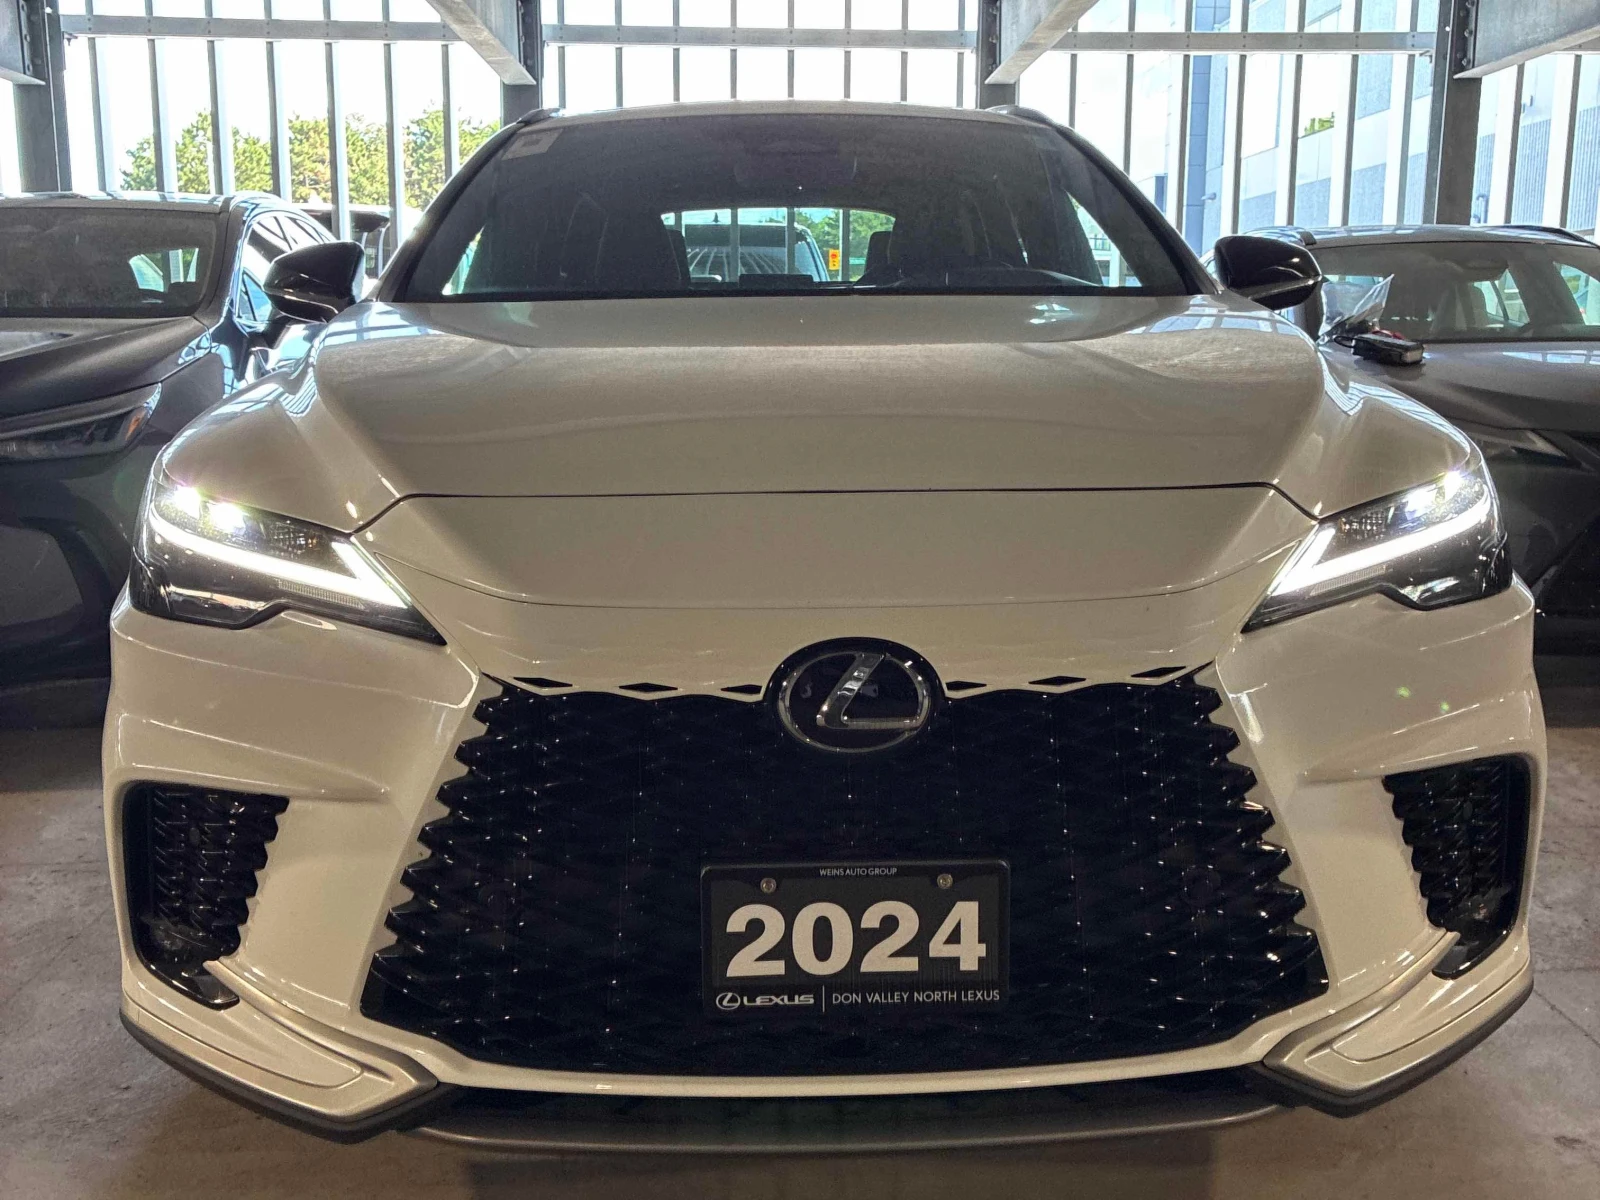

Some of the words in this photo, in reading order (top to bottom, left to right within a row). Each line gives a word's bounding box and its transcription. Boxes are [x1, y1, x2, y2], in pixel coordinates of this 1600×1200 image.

[819, 867, 844, 876] WEINS
[845, 867, 867, 876] AUTO
[868, 867, 898, 875] GROUP
[726, 900, 986, 977] 2024
[743, 994, 815, 1006] LEXUS
[832, 992, 862, 1004] DON
[865, 991, 910, 1003] VALLEY
[914, 990, 957, 1002] NORTH
[961, 989, 1000, 1001] LEXUS
